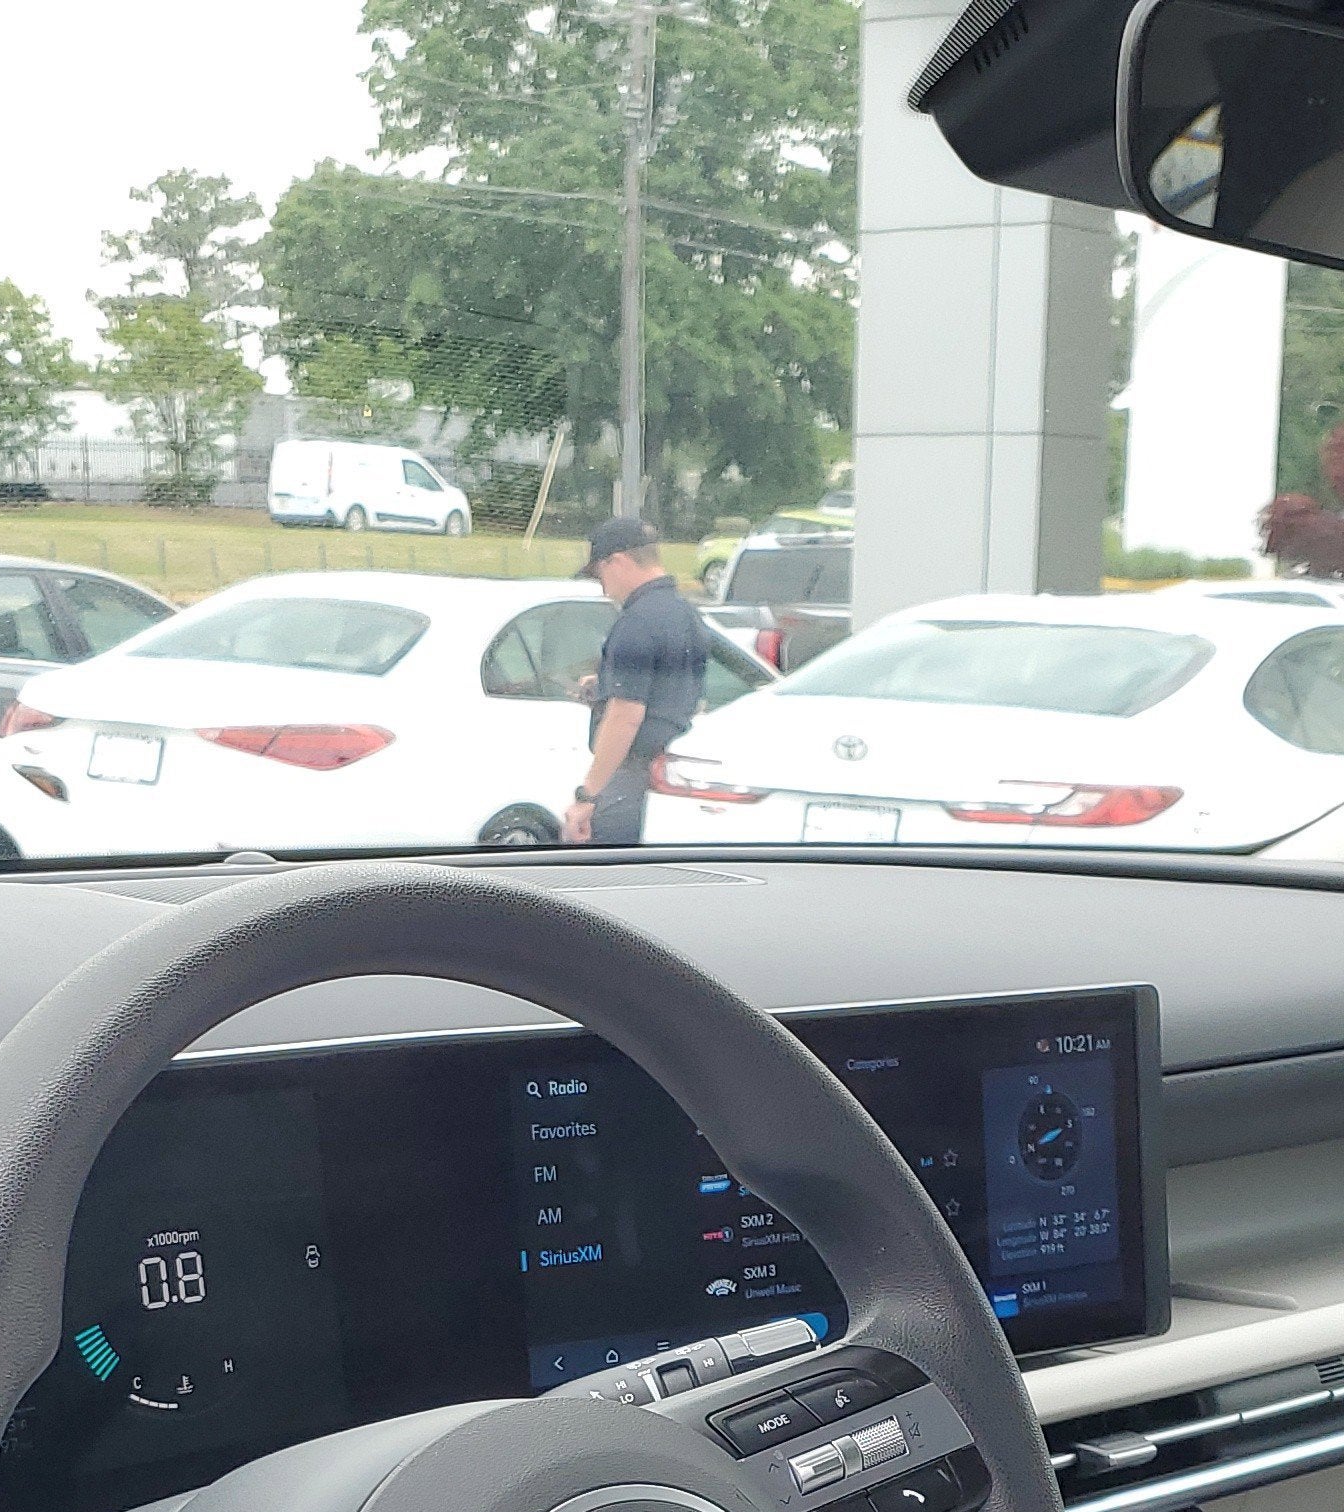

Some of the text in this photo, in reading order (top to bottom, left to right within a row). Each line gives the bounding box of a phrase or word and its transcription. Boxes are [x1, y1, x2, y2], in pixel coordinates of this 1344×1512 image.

[1056, 1034, 1110, 1053] 10:21 AM
[847, 1057, 900, 1072] Categories
[548, 1079, 588, 1096] Radio
[531, 1122, 597, 1141] Favorites
[534, 1166, 557, 1182] FM
[537, 1207, 562, 1226] AM
[741, 1213, 774, 1229] SXM 2
[1039, 1217, 1047, 1227] N
[147, 1230, 200, 1248] x1000rpm
[1039, 1230, 1049, 1240] W
[540, 1244, 602, 1266] SiriusXM
[139, 1251, 206, 1309] 0.8
[743, 1264, 776, 1280] SXM 3
[1021, 1281, 1041, 1295] SXM
[224, 1358, 234, 1373] H
[702, 1357, 715, 1368] HI
[133, 1376, 142, 1390] C
[615, 1380, 627, 1390] HI
[619, 1393, 635, 1405] LO
[758, 1413, 792, 1434] MODE
